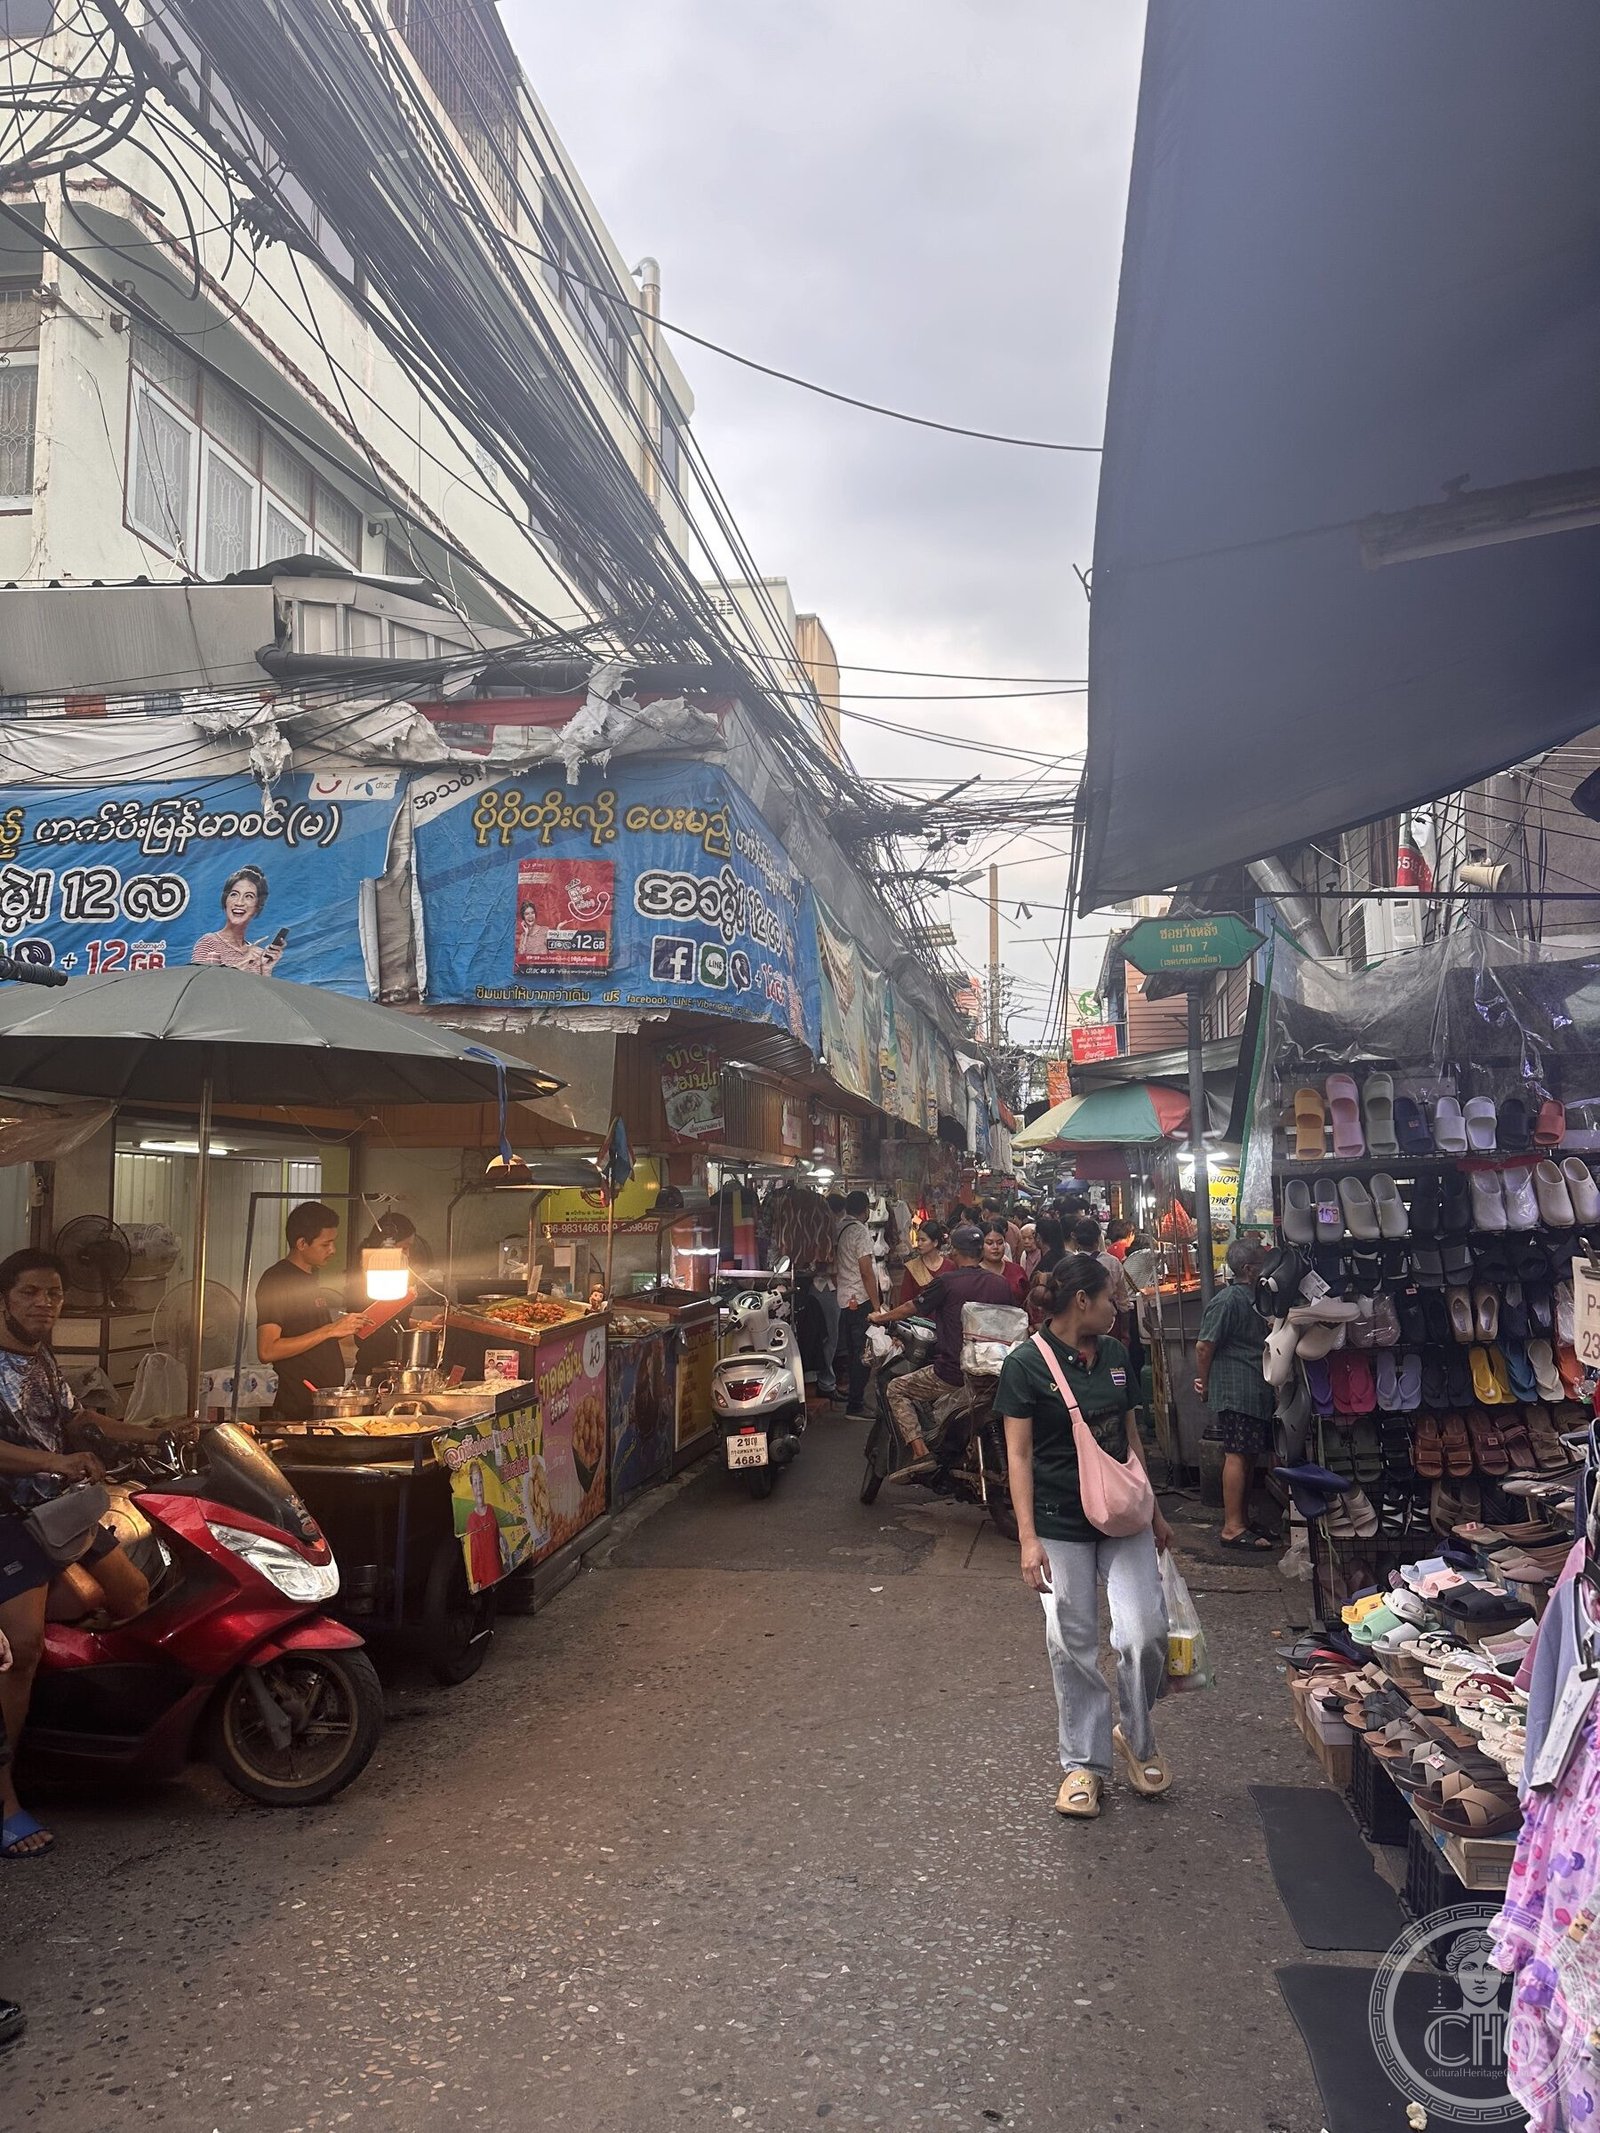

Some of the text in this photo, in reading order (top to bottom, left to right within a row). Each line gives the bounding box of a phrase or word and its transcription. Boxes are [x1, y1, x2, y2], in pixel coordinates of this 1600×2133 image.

[375, 781, 392, 789] dtac
[1160, 922, 1218, 940] ซอยวังหลัง
[576, 934, 592, 949] 12
[592, 940, 605, 950] GB
[1171, 941, 1208, 953] แยก 7
[707, 959, 724, 970] LINE
[602, 988, 621, 1003] ฟรี
[538, 1339, 583, 1401] ทอดมัน
[735, 1454, 761, 1465] 4683
